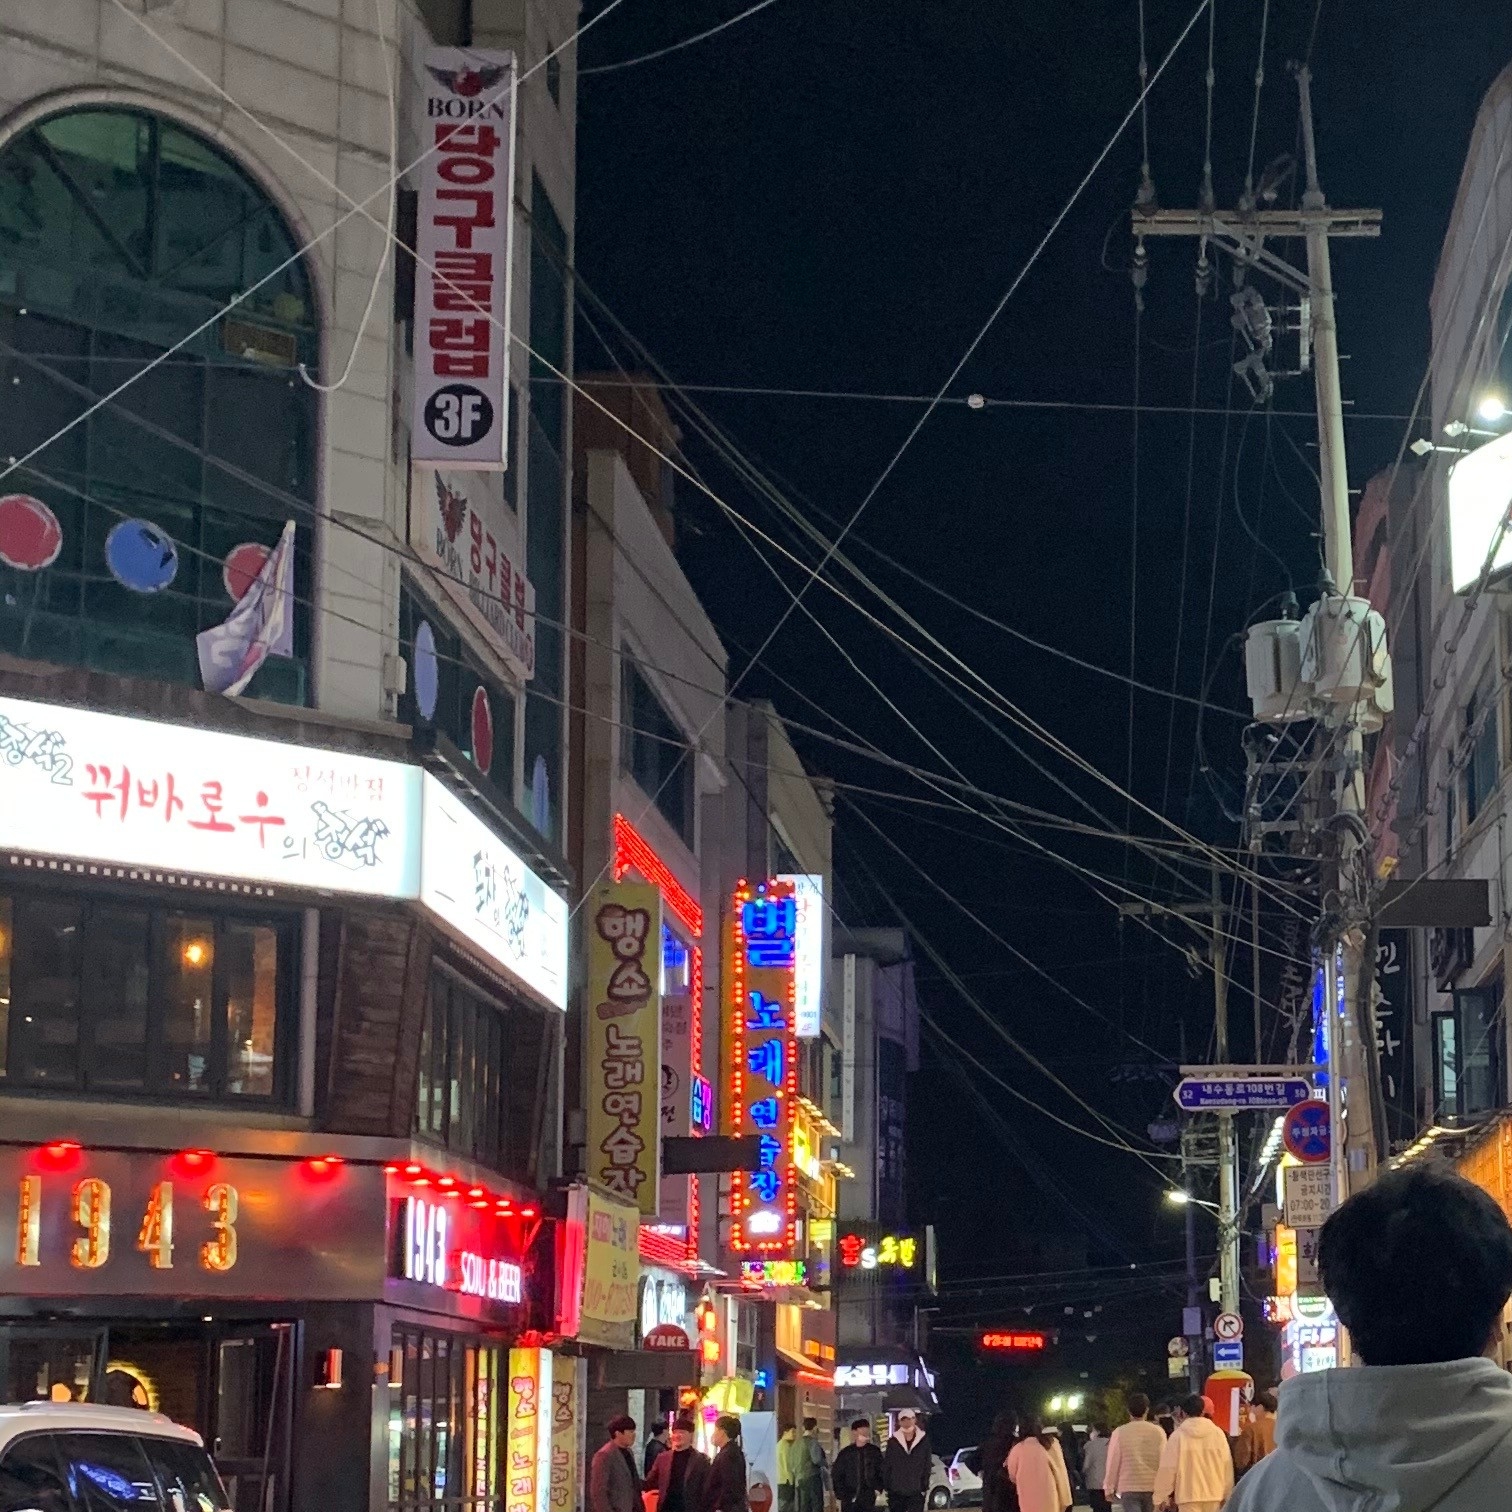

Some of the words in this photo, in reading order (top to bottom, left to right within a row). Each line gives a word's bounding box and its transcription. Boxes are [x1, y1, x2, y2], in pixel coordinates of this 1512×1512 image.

[427, 98, 504, 120] BORN
[428, 124, 501, 379] 당구클럽
[434, 395, 483, 439] 3F
[1181, 1089, 1194, 1100] 32
[1291, 1125, 1331, 1138] 주정차금
[16, 1174, 240, 1272] 1943
[405, 1195, 447, 1288] 1943
[460, 1250, 487, 1297] SOJU
[487, 1258, 497, 1299] &
[498, 1260, 522, 1304] BEER
[650, 1334, 686, 1348] TAKE
